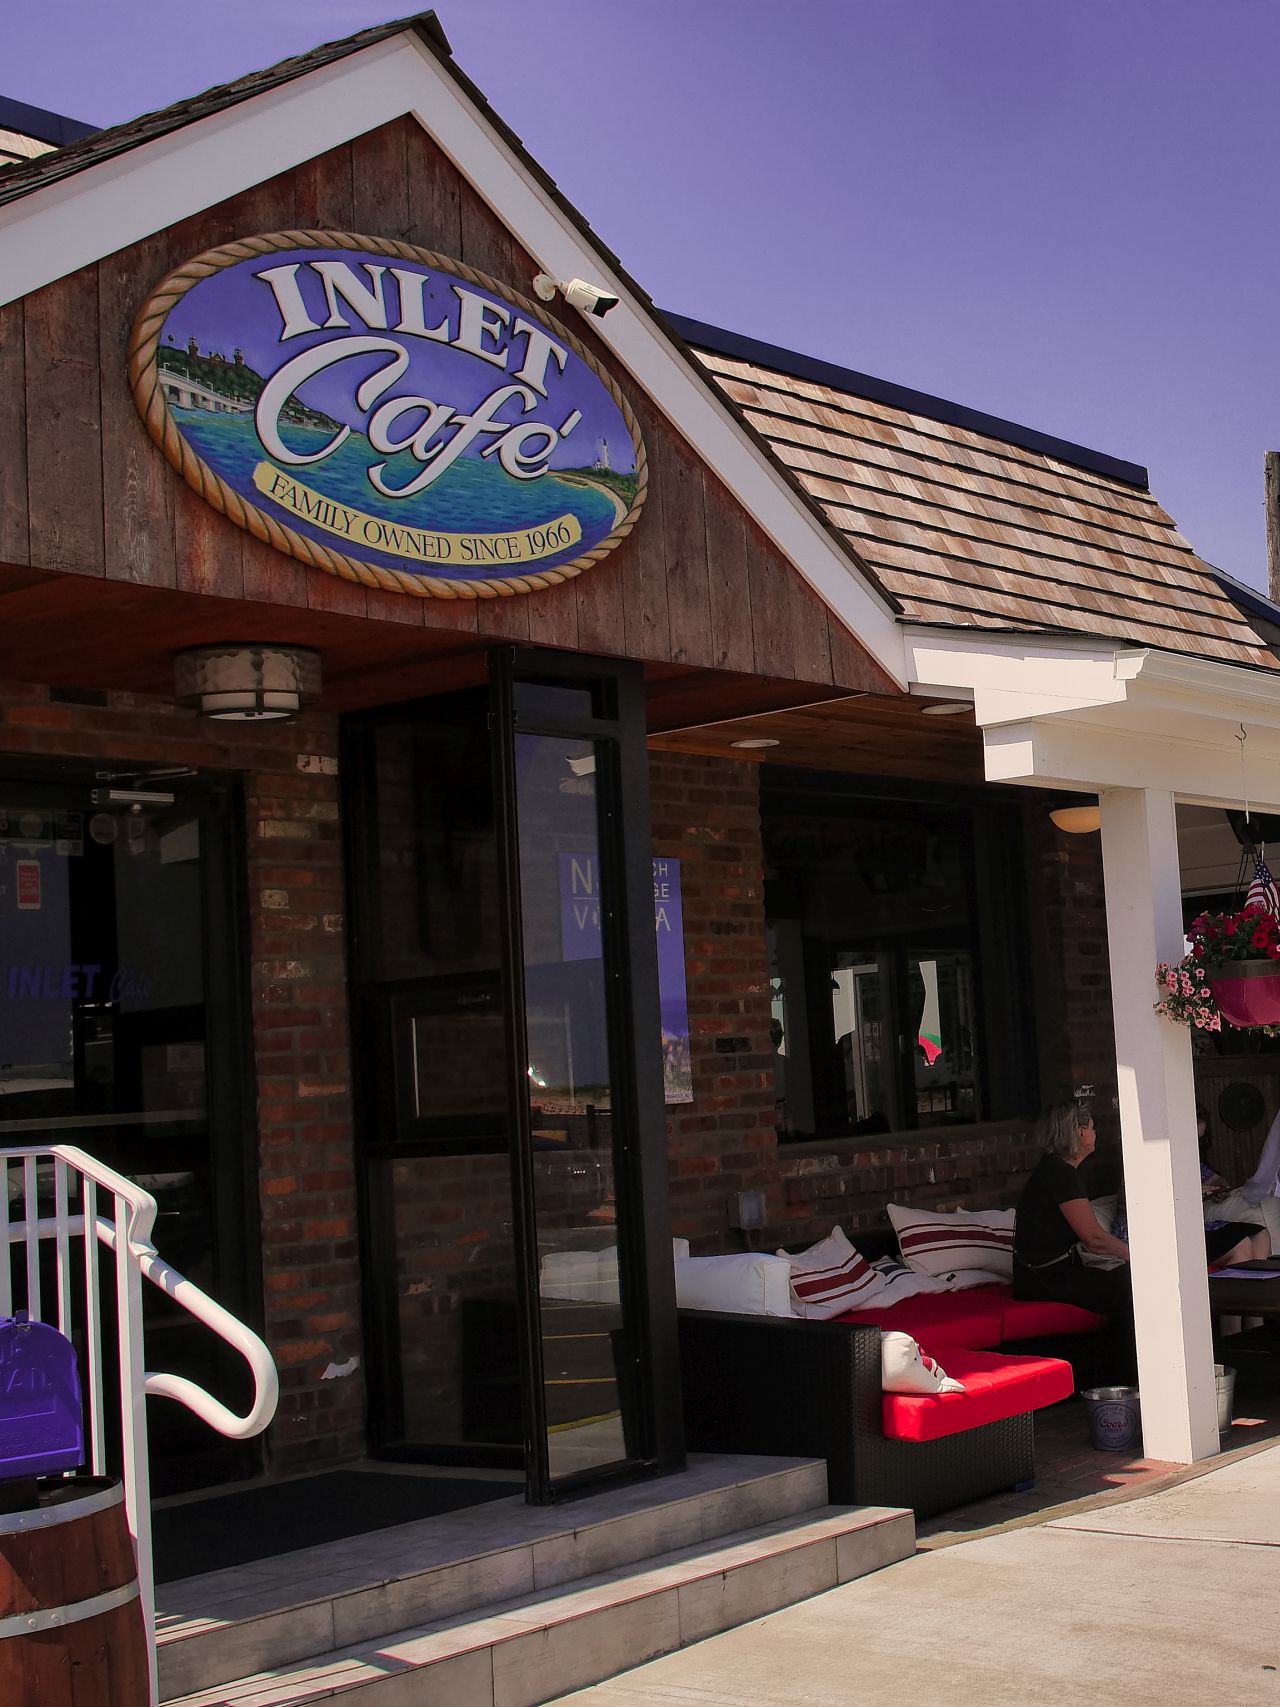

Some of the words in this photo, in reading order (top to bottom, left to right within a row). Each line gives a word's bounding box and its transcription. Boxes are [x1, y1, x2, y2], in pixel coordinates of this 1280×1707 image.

[256, 261, 568, 396] INLET
[255, 336, 582, 497] Café
[271, 473, 360, 535] FAMILY
[363, 520, 451, 560] OWNED
[460, 537, 521, 561] SINCE
[525, 524, 571, 558] 1966
[7, 964, 102, 999] INLET
